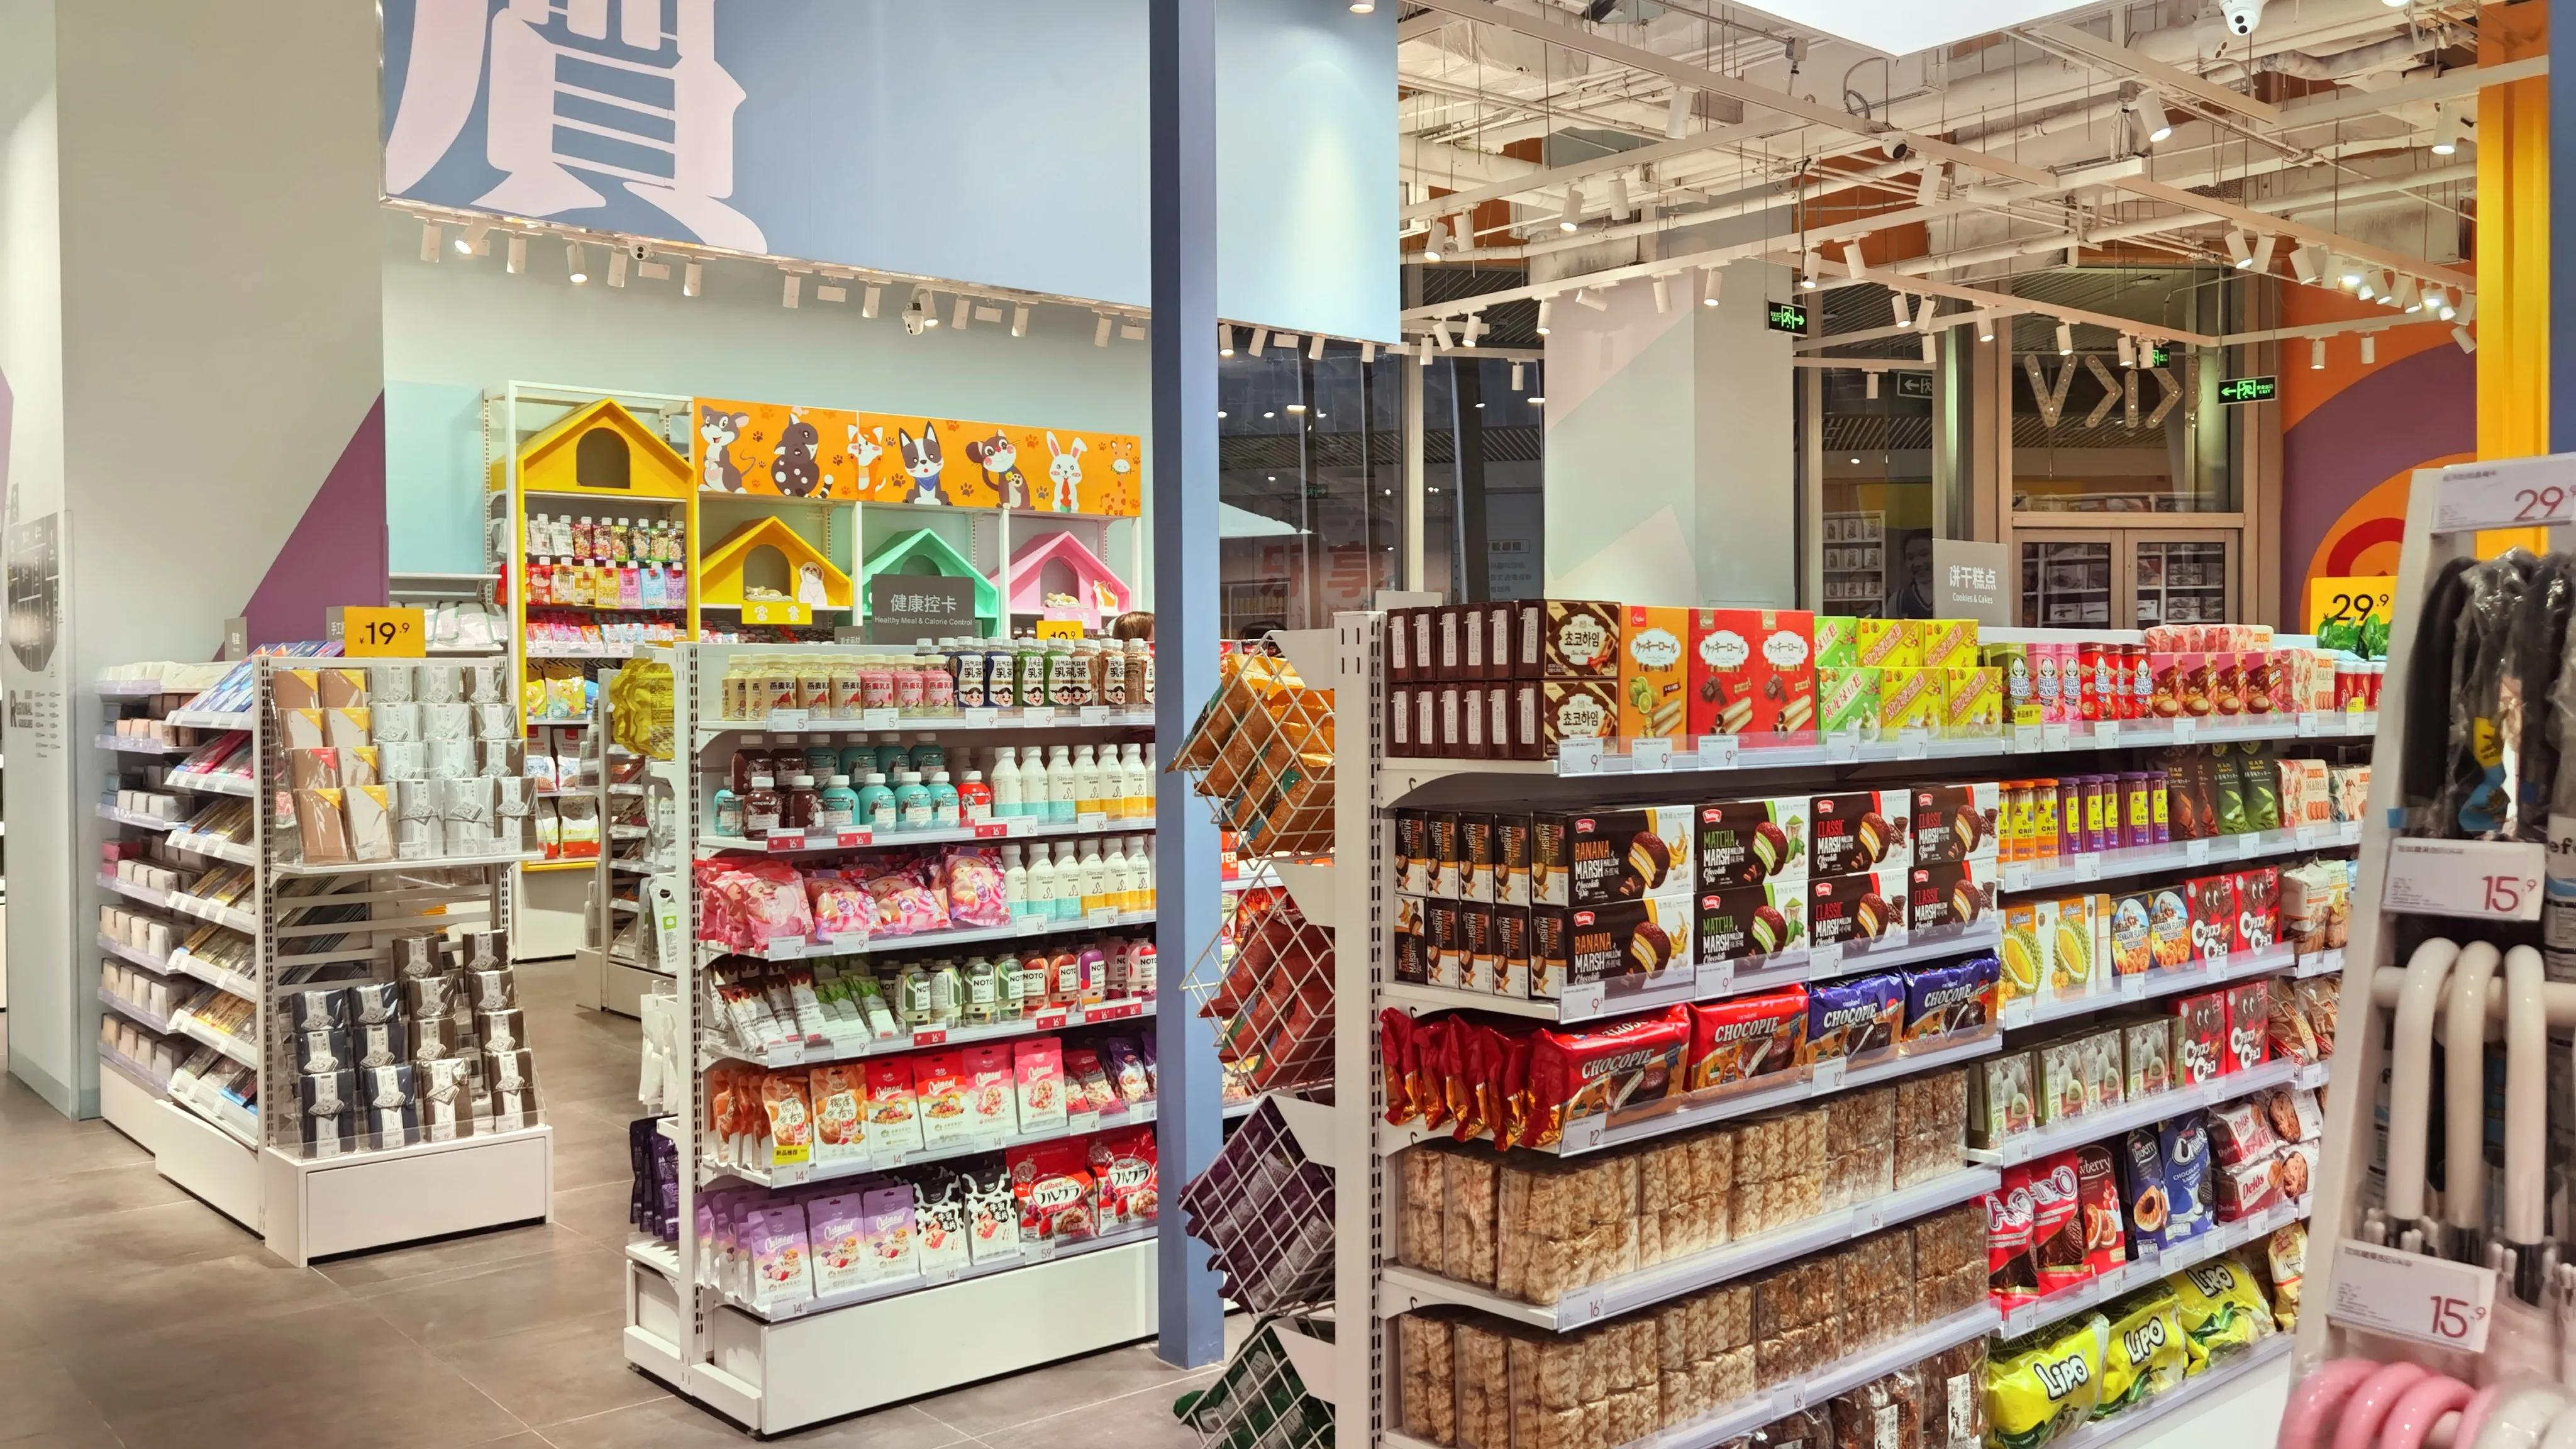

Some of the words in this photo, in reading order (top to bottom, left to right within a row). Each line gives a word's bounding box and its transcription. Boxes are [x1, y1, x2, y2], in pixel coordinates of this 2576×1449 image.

[1950, 565, 1996, 591] 饼干糕点
[891, 594, 957, 613] 健康控卡
[1953, 592, 1972, 602] Cookies
[1974, 594, 1977, 602] &
[1978, 595, 1992, 604] Cakes
[875, 616, 901, 625] Healthy
[924, 617, 947, 625] Calorie
[1818, 819, 1845, 837] CLASSIC
[1919, 812, 1942, 828] CLASSIC
[1503, 826, 1511, 852] MARSH
[1541, 824, 1550, 850] MARSH
[1704, 830, 1735, 848] MATCHA
[1818, 836, 1840, 854] MARSH
[1919, 828, 1939, 845] MARSH
[1575, 840, 1609, 861] BANANA
[1704, 848, 1729, 867] MARSH
[1575, 859, 1603, 880] MARSH
[1604, 858, 1619, 867] MALLOW
[1915, 887, 1940, 904] CLASSIC
[1816, 902, 1843, 920] CLASSIC
[1915, 904, 1936, 921] MARSH
[1703, 916, 1734, 936] MATCHA
[1816, 919, 1839, 938] MARSH
[2153, 923, 2171, 934] DENMARK
[2172, 919, 2186, 929] FLAVOR
[1575, 933, 1612, 954] BANANA
[1703, 933, 1729, 954] MARSH
[2117, 931, 2135, 941] DENMARK
[1575, 952, 1605, 973] MARSH
[1606, 949, 1621, 958] MALLOW
[917, 985, 930, 993] NOT
[974, 977, 993, 987] NOTO
[1824, 1002, 1878, 1028] CHOCOPIE
[1714, 1016, 1780, 1043] CHOCOPIE
[1028, 1063, 1053, 1080] Oatmeal
[1582, 1048, 1655, 1079] CHOCOPIE
[928, 1077, 955, 1096] Oatmeal
[975, 1070, 1002, 1087] Oatmeal
[875, 1083, 902, 1101] Oatmeal
[1040, 1180, 1063, 1191] Calbee
[1110, 1167, 1149, 1186] フルグラ
[1034, 1187, 1080, 1204] フルグラ
[824, 1220, 853, 1240] Oatmeal
[876, 1212, 905, 1230] Oatmeal
[765, 1233, 795, 1252] Oatmeal
